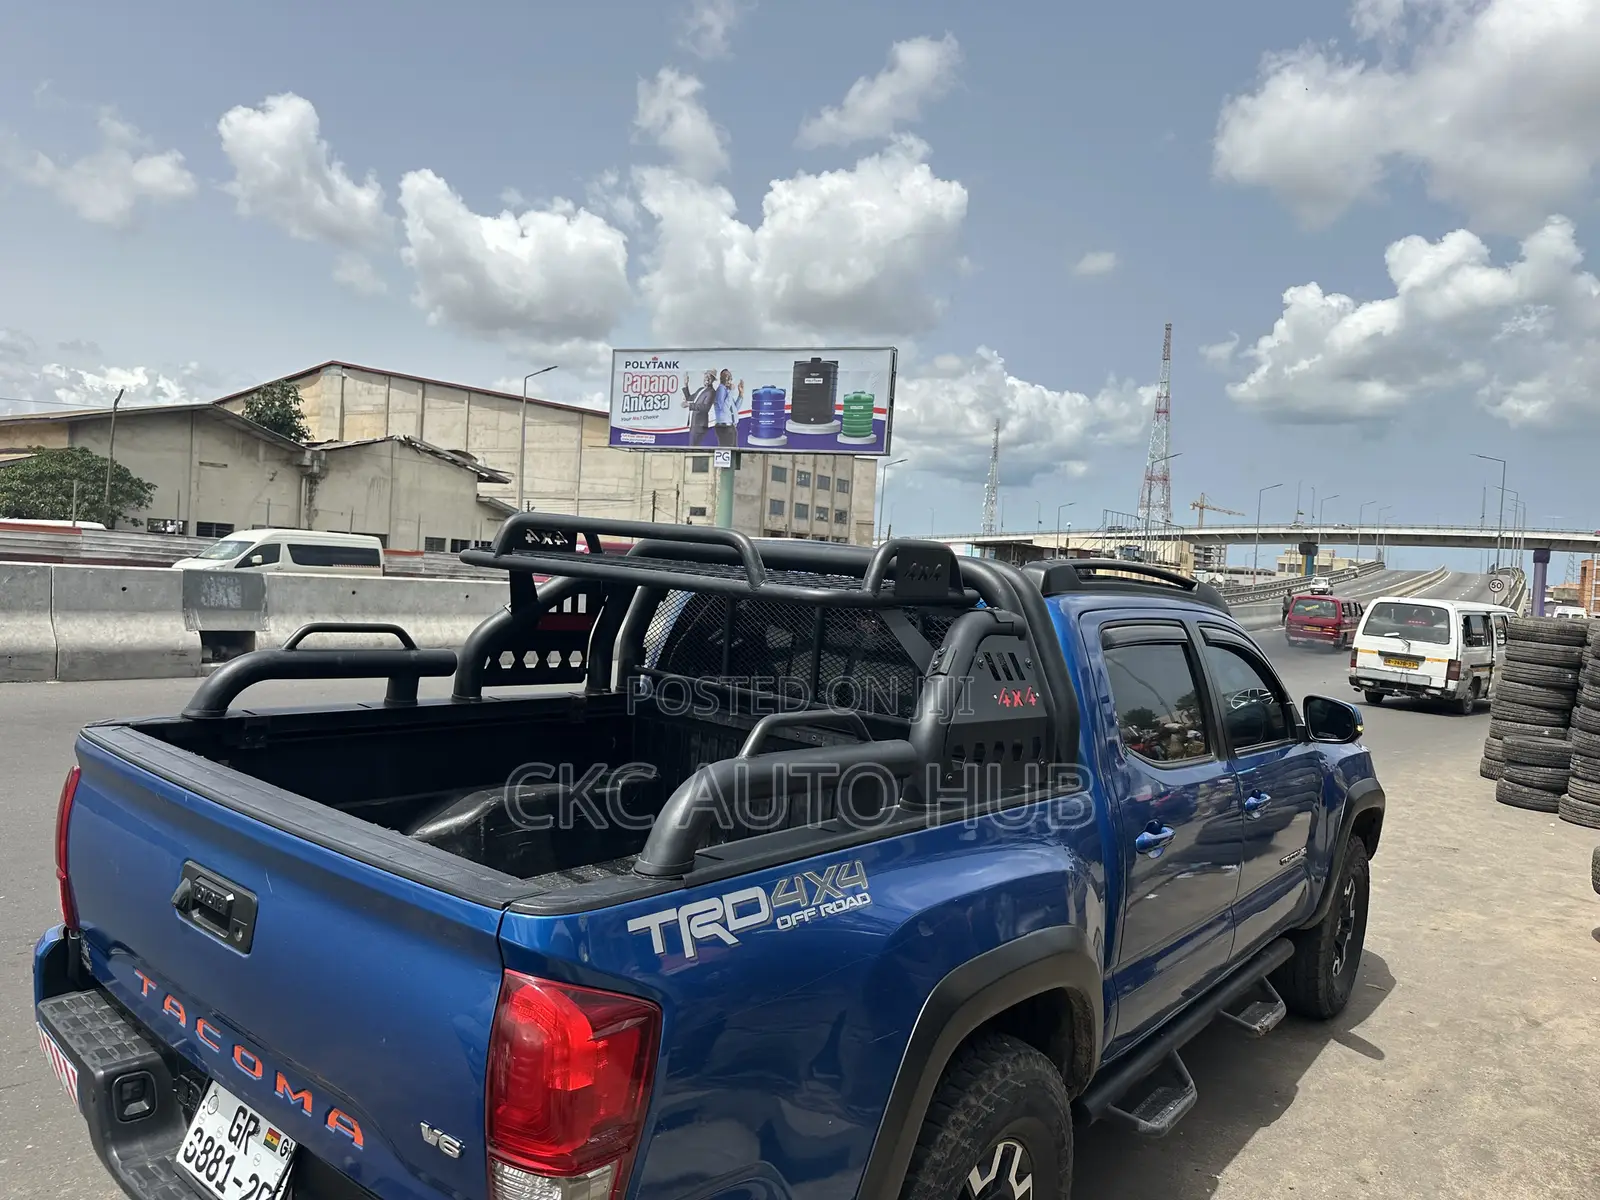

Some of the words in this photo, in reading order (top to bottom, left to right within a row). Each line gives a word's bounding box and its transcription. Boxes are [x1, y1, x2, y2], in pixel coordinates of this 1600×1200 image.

[625, 360, 680, 369] POLYTANK
[622, 371, 679, 396] Papano
[621, 393, 670, 414] Ankasa
[715, 451, 730, 462] PG
[626, 886, 774, 960] TRD
[771, 860, 869, 908] 4X4
[776, 906, 817, 931] OFF
[820, 892, 872, 918] ROAD
[133, 968, 365, 1151] TACOMA
[228, 1105, 261, 1156] GR
[420, 1121, 462, 1158] V6
